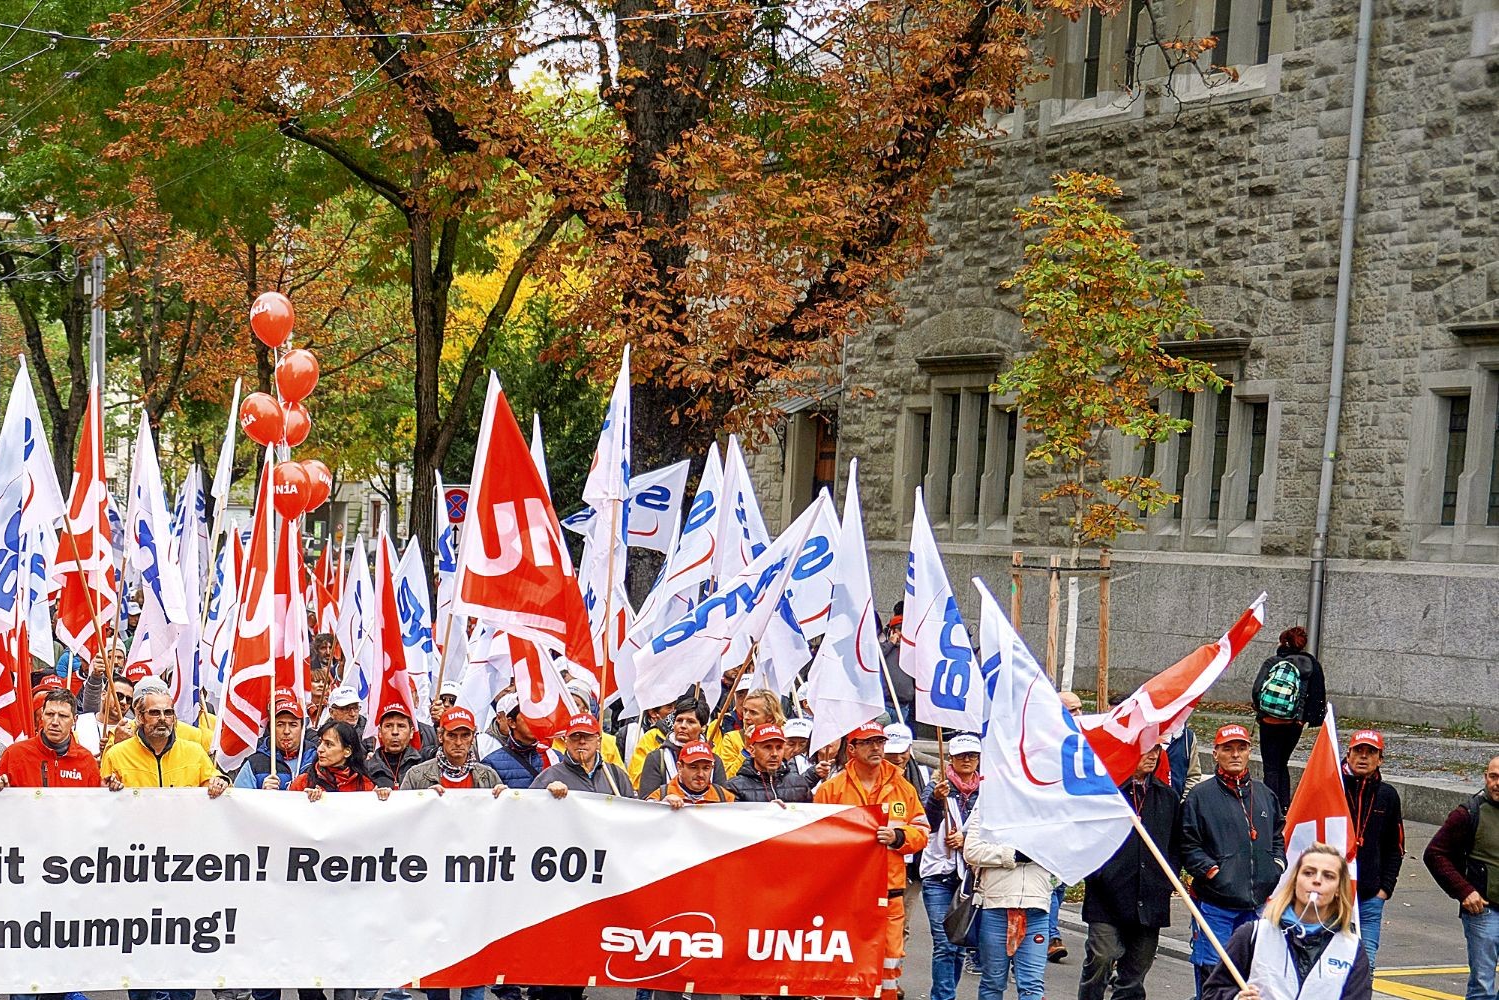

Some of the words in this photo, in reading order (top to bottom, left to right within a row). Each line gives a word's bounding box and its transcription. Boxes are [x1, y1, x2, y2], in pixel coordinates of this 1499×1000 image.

[251, 301, 273, 316] NiA
[273, 481, 299, 495] NiA
[60, 768, 82, 781] UNiA
[42, 844, 271, 885] schützen!
[287, 846, 428, 883] Rente
[445, 846, 516, 883] mit
[531, 846, 608, 884] 60!
[601, 927, 724, 963] syna
[747, 915, 854, 964] UNiA
[1327, 957, 1352, 973] syn
